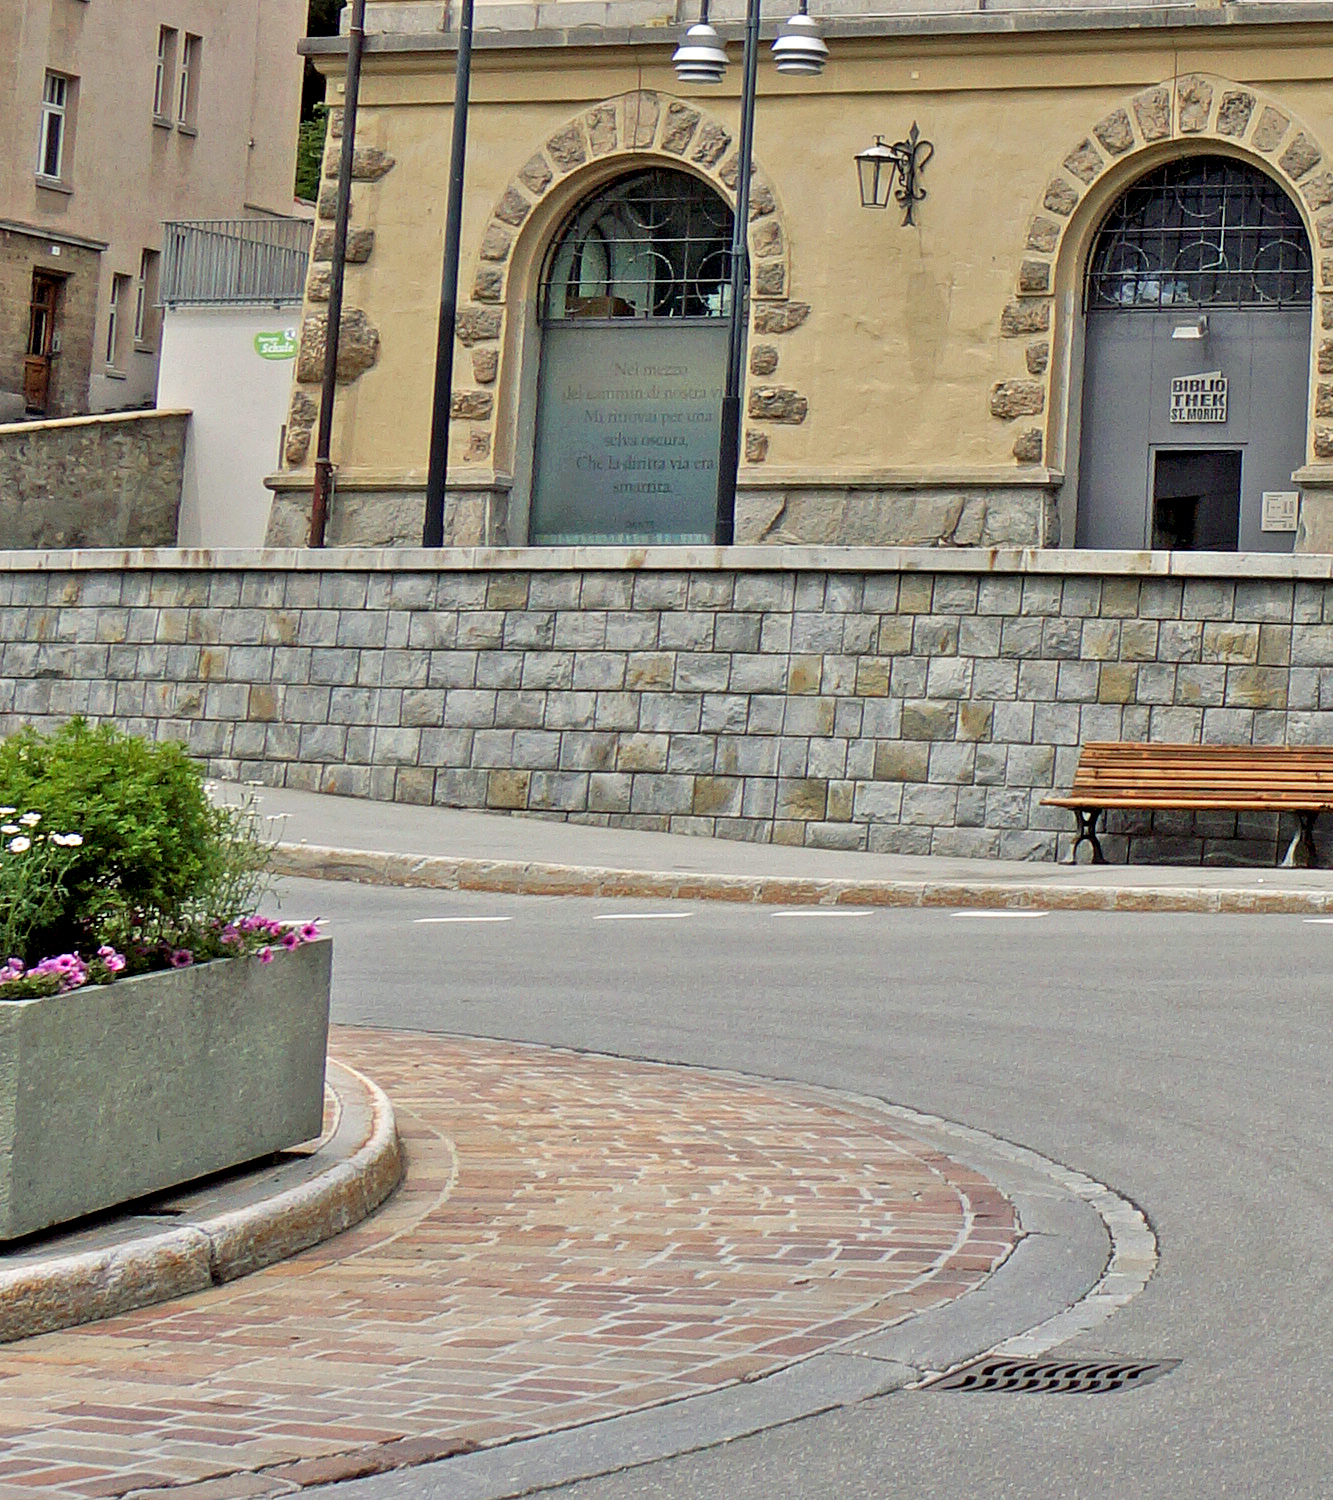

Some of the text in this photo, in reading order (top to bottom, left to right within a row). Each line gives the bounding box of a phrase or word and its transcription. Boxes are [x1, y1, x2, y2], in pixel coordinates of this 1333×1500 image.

[1173, 380, 1226, 393] BIBLIO
[1171, 394, 1225, 407] THEK
[1171, 408, 1225, 420] ST. MORITZ
